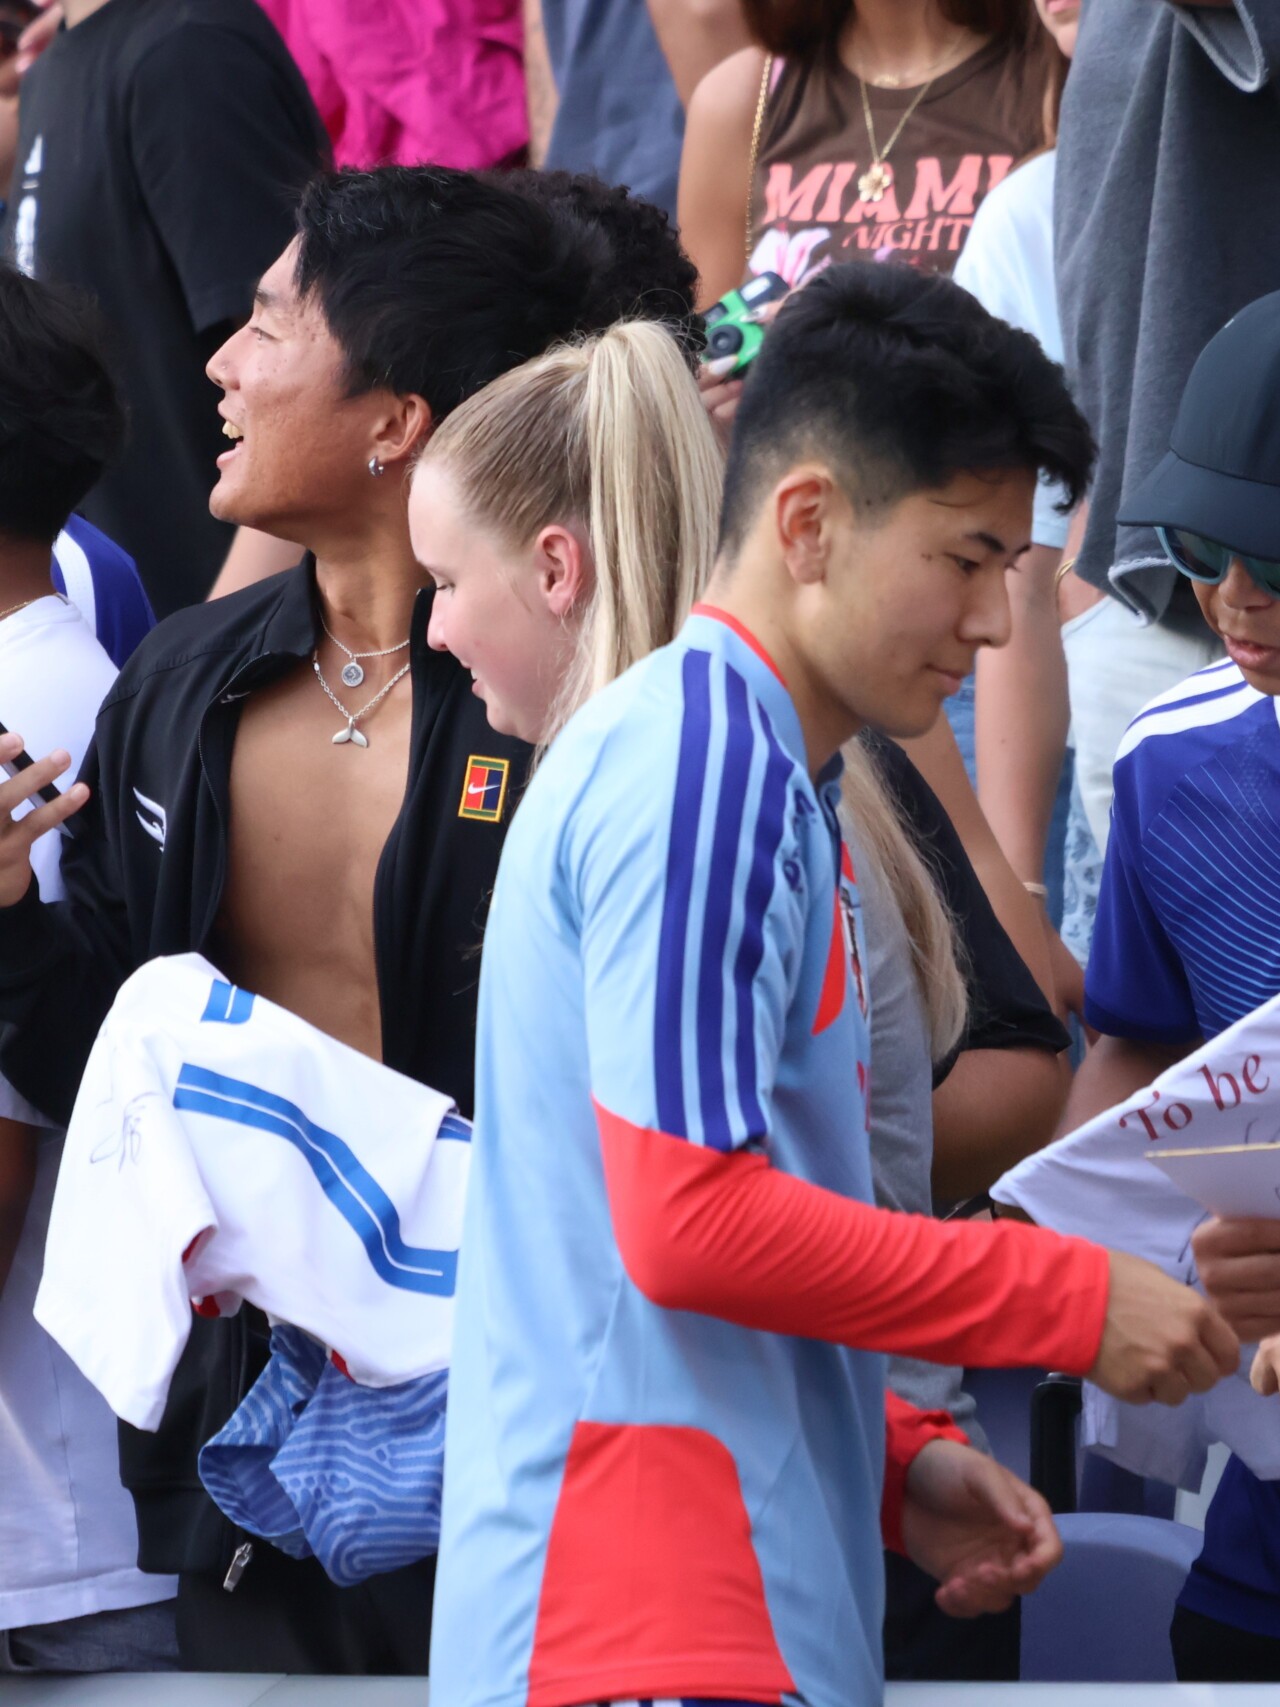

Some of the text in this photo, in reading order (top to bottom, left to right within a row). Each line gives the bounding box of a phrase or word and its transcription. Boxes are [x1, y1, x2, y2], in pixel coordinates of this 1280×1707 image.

[762, 154, 1013, 224] MIAMI
[1118, 1090, 1193, 1141] To
[1196, 1063, 1270, 1112] be
